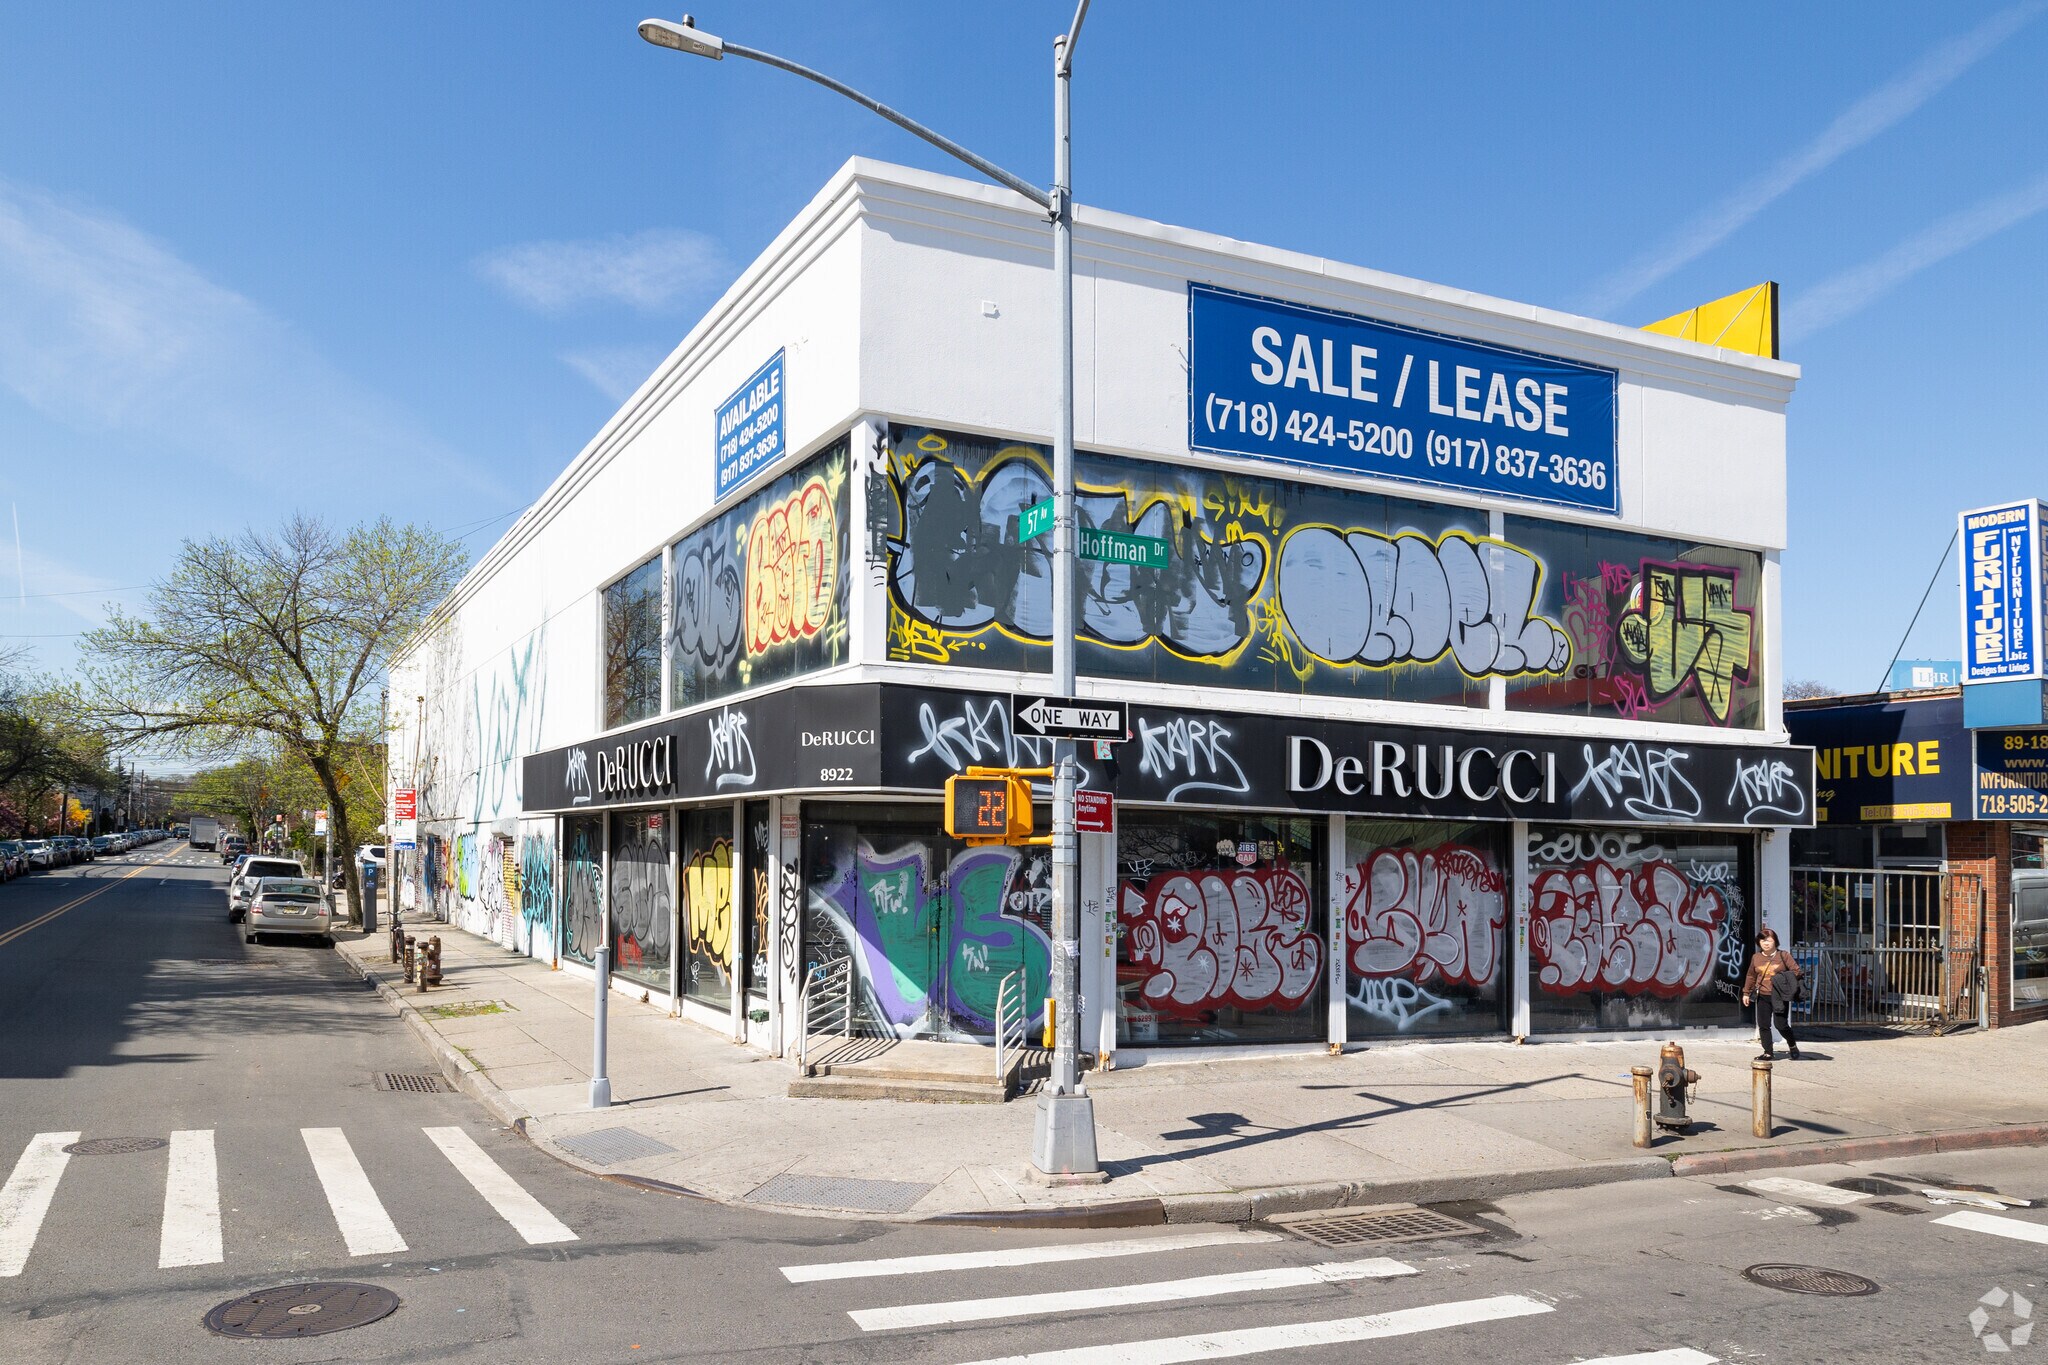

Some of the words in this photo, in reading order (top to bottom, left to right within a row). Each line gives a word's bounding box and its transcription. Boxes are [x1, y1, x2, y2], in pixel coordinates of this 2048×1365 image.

[1251, 326, 1378, 402] SALE
[1393, 355, 1414, 408] /
[1429, 360, 1569, 437] LEASE
[720, 368, 779, 441] AVAILABLE
[721, 435, 738, 464] (718)
[739, 403, 778, 447] 424-5200
[1206, 393, 1278, 441] (718)
[1285, 410, 1413, 459] 424-5200
[1426, 430, 1488, 475] (917)
[1495, 445, 1606, 490] 837-3636
[721, 460, 738, 487] (917)
[739, 430, 778, 473] 837-3636
[1028, 510, 1038, 535] 57
[1041, 507, 1047, 519] Av
[1968, 508, 2025, 530] MODERN
[1080, 532, 1147, 562] Hoffman
[1155, 542, 1165, 557] Dr
[1973, 529, 2003, 664] FURNITURE
[2011, 535, 2023, 649] NYFURNITURE
[1971, 666, 1997, 676] Designs
[1997, 665, 2007, 673] for
[2009, 663, 2030, 673] Livings
[2009, 651, 2028, 661] .biz
[1031, 708, 1062, 725] ONE
[1079, 711, 1112, 727] WAY
[801, 729, 875, 747] DeRUCCI
[2004, 736, 2048, 750] 89-18
[598, 736, 671, 793] DeRUCCI
[820, 768, 853, 781] 8922
[1285, 735, 1555, 804] DeRUCCI
[1980, 772, 2048, 789] NYFURNITUR
[978, 791, 1005, 827] 22
[1078, 804, 1096, 813] Anytime
[1085, 795, 1107, 804] STANDING
[1981, 795, 2048, 813] 718-505-2
